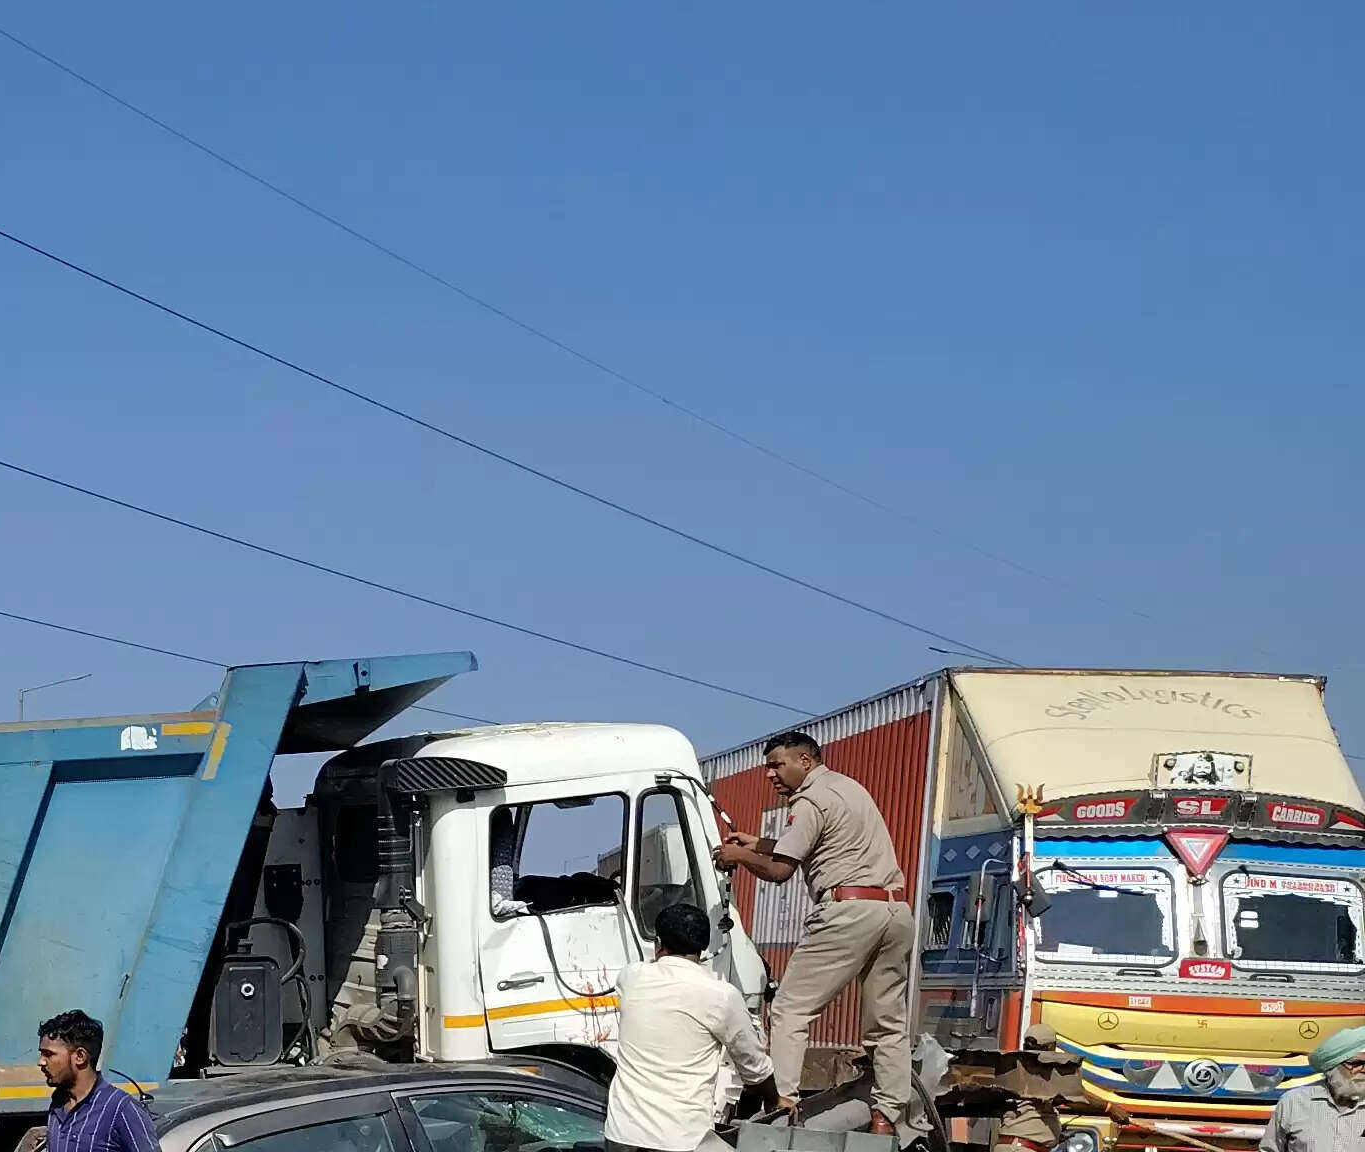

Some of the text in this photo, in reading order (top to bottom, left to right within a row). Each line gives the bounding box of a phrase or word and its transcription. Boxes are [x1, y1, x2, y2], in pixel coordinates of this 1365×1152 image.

[1076, 800, 1321, 825] GOODS SL CARRIER
